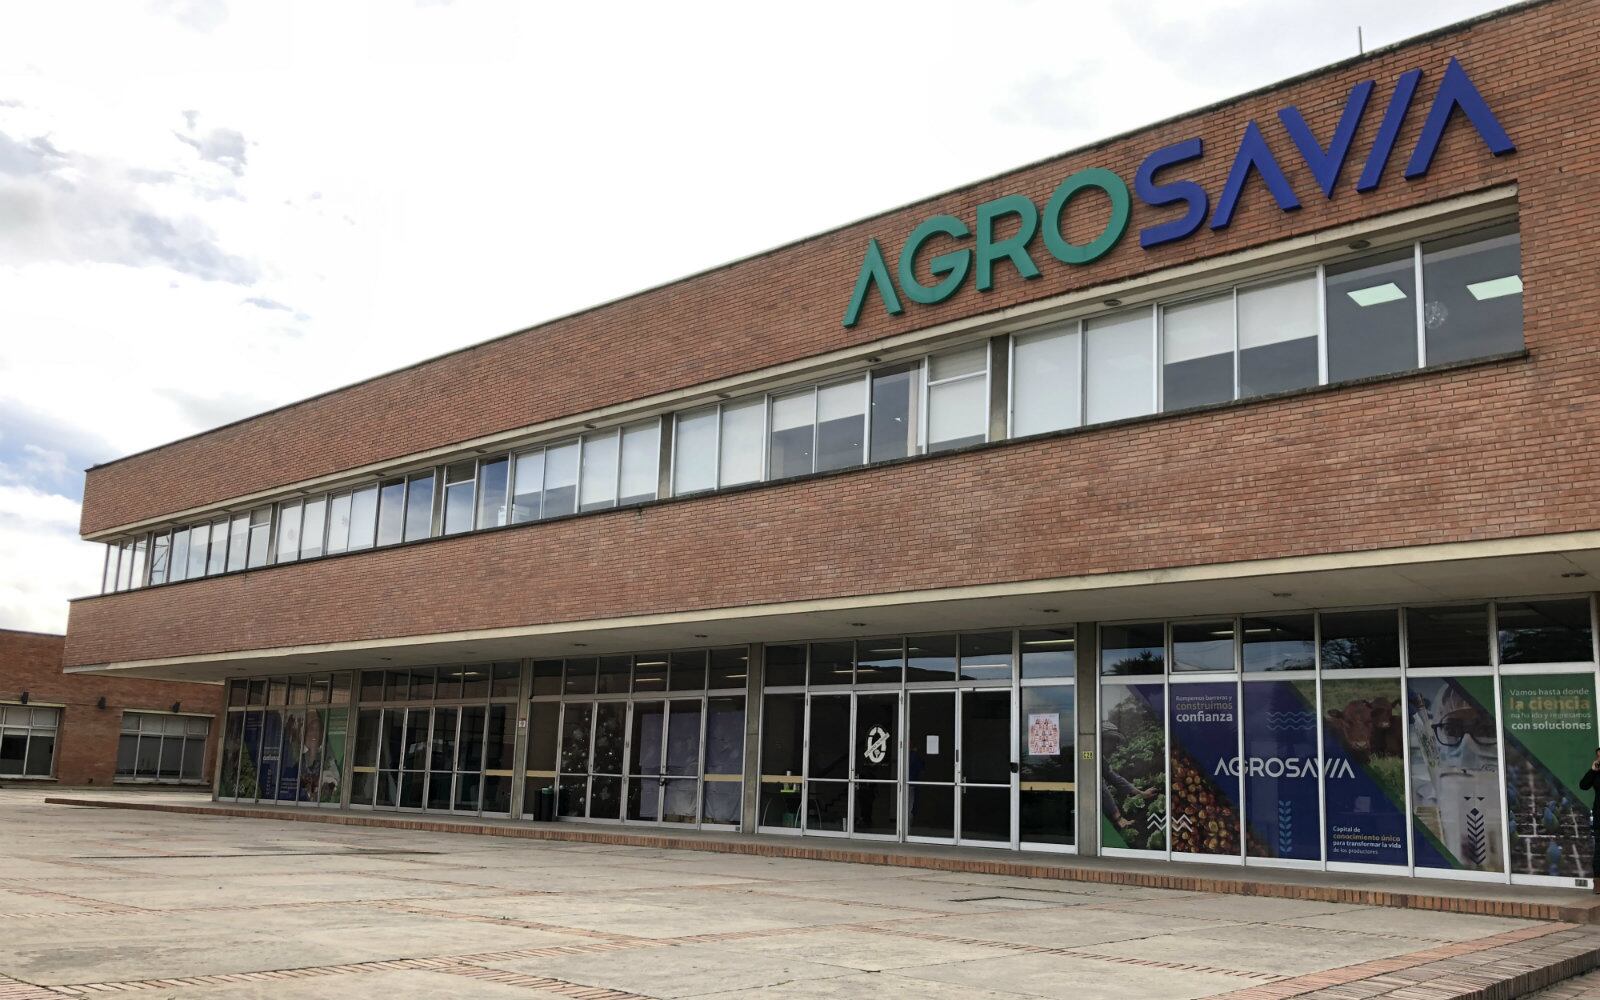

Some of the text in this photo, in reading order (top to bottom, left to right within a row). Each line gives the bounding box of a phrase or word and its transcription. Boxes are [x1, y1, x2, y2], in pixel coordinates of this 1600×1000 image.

[843, 55, 1517, 329] AGROSAVIA
[1538, 688, 1561, 696] hasta
[1562, 687, 1591, 695] donde
[1175, 702, 1233, 710] construimos
[1509, 696, 1590, 710] la ciencia
[1175, 710, 1233, 722] confianza
[1511, 720, 1592, 730] con soluciones
[1214, 756, 1356, 779] AGROSAVIA
[1332, 825, 1353, 833] Capital
[1332, 833, 1380, 841] conocimiento
